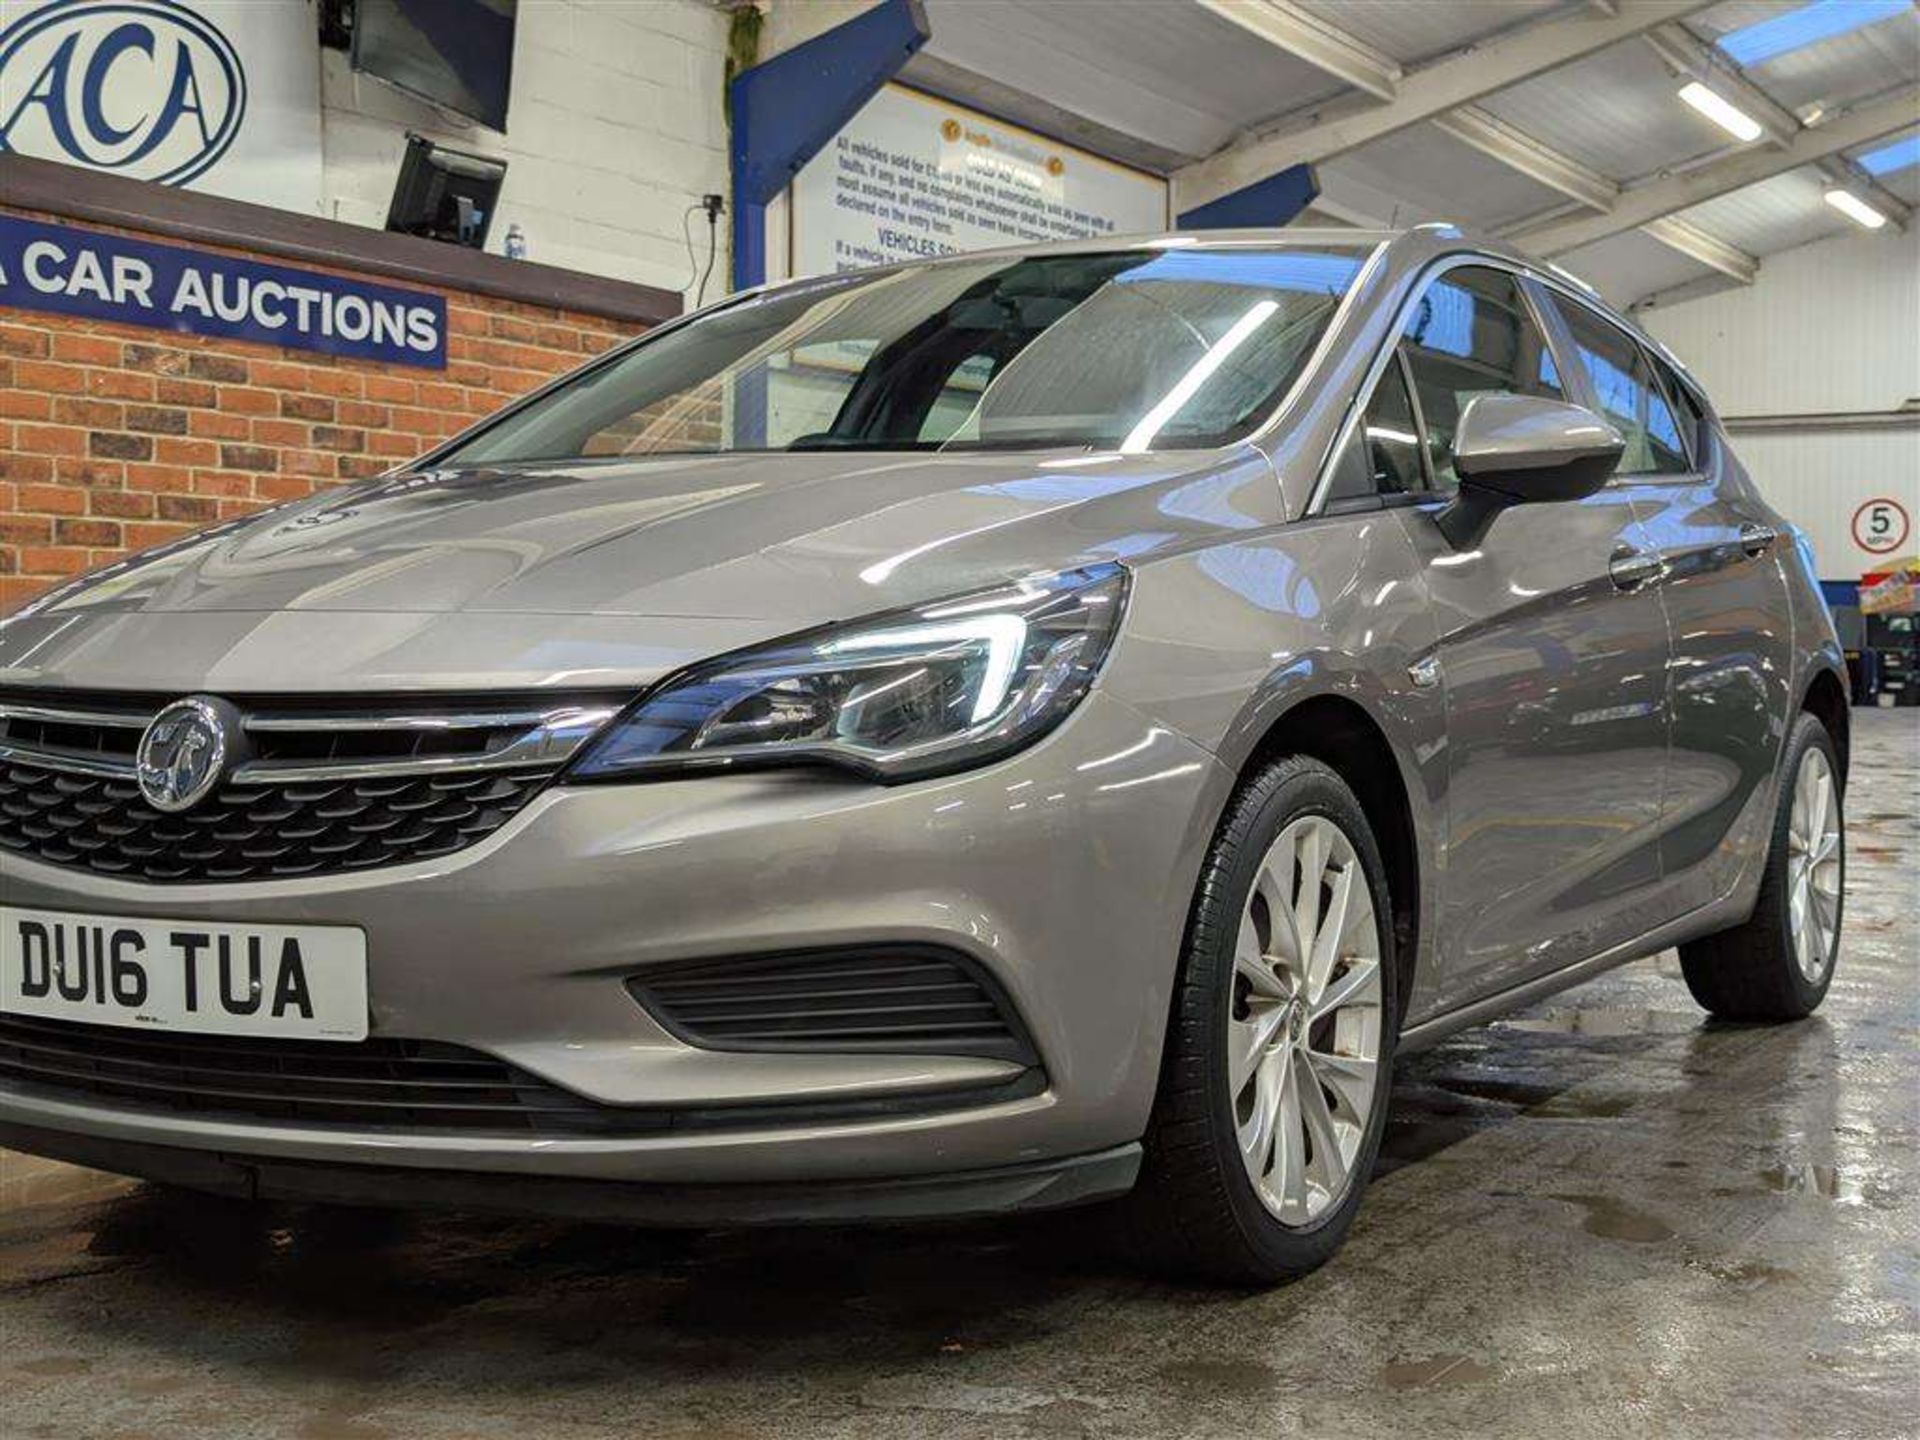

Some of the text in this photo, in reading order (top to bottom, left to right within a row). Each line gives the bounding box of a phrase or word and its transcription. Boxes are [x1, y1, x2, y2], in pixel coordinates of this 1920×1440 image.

[2, 22, 213, 168] ACA
[837, 175, 860, 192] must
[862, 183, 897, 201] assume
[899, 190, 911, 206] all
[912, 197, 947, 217] vehicles
[948, 206, 965, 221] sold
[851, 142, 889, 164] vehicles
[890, 153, 910, 171] sold
[911, 158, 925, 173] for
[997, 188, 1046, 214] automatically
[899, 175, 915, 190] and
[917, 181, 928, 193] no
[930, 182, 974, 207] complaints
[975, 199, 1019, 219] whatsoever
[836, 193, 877, 215] declared
[878, 206, 890, 219] on
[891, 207, 906, 222] the
[908, 213, 930, 232] entry
[853, 246, 885, 262] vehicle
[877, 229, 937, 256] VEHICLES
[23, 240, 438, 352] CAR AUCTIONS
[1871, 507, 1890, 534] 5
[19, 920, 314, 1019] DU16 TUA
